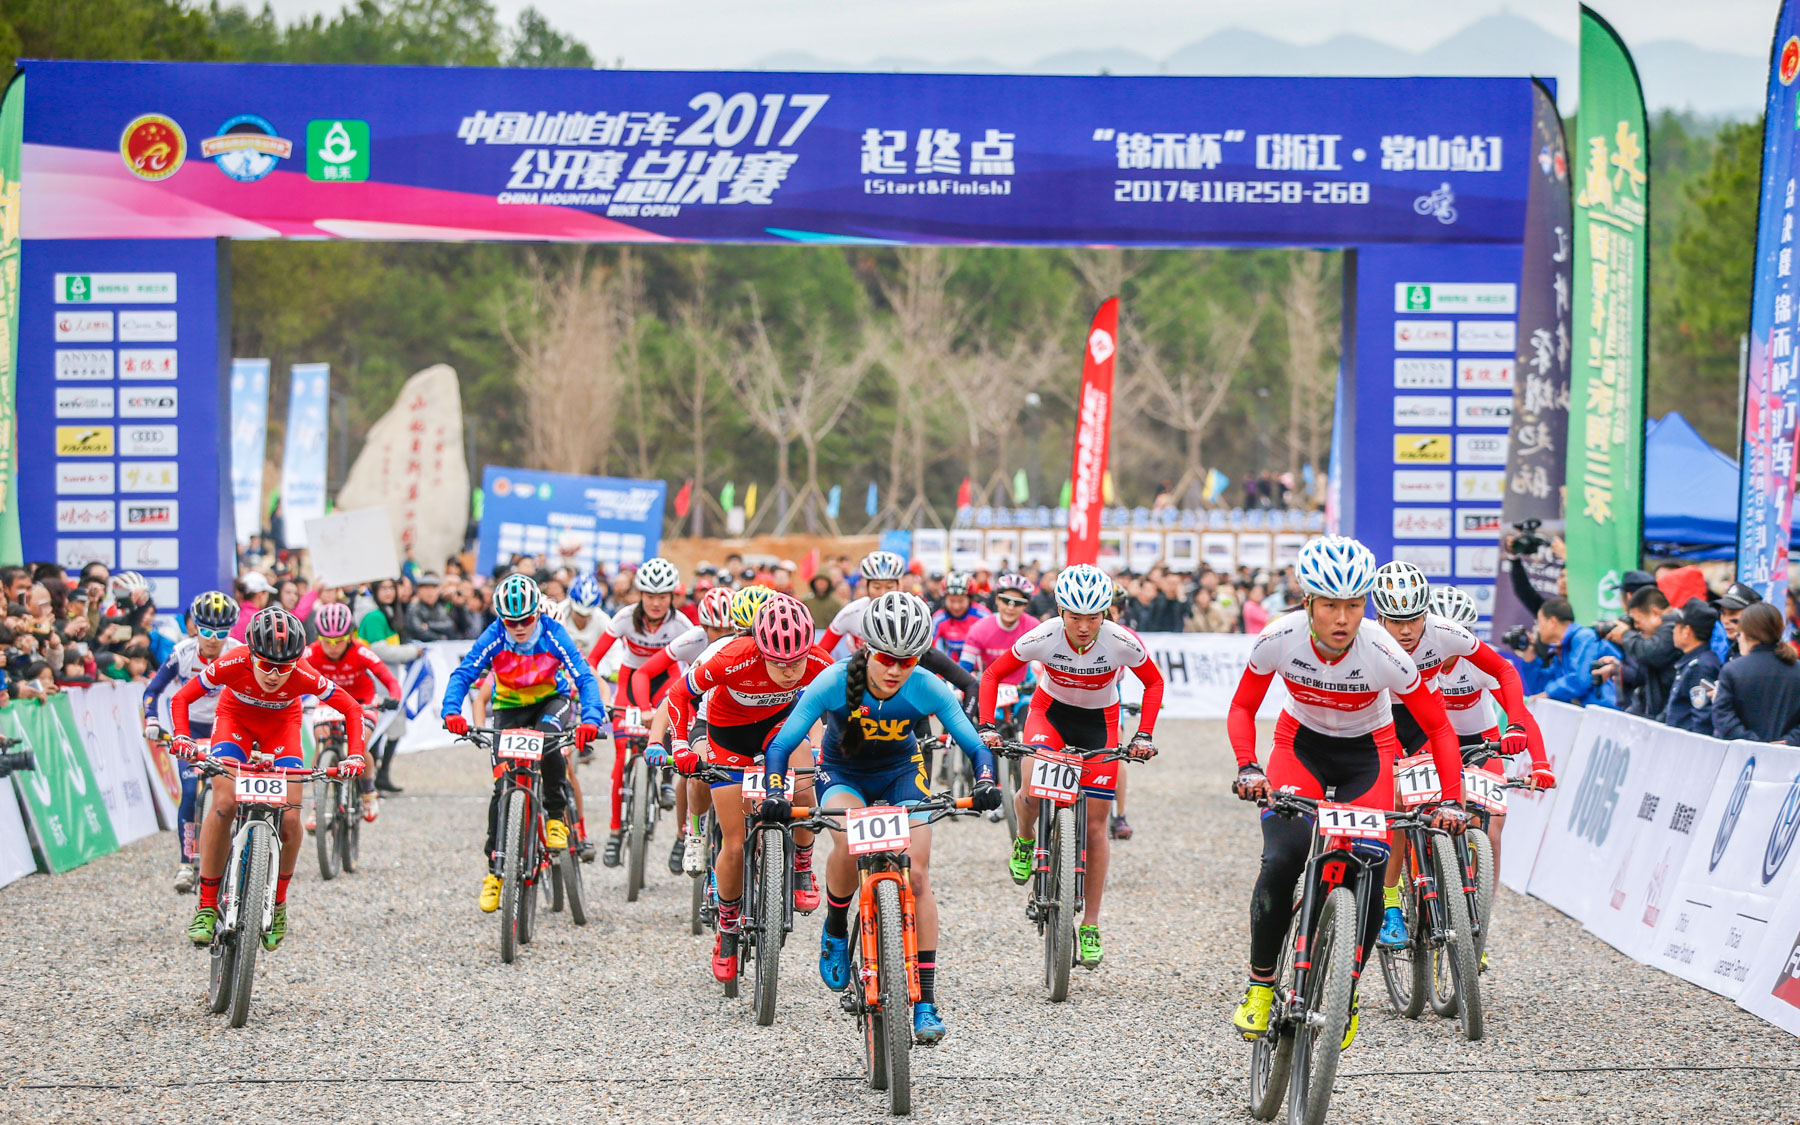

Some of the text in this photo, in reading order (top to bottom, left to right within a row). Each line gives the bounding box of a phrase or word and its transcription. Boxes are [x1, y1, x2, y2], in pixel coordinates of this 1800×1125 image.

[457, 92, 830, 148] 中国山地自行车 2017
[860, 128, 1016, 175] 起终点
[506, 149, 799, 205] 公开赛 总决赛
[497, 190, 612, 207] CHINA MOUNTAIN
[606, 203, 681, 218] BIKE OPEN
[219, 656, 246, 669] Santic
[1284, 671, 1371, 692] IRC轮胎中国车队
[503, 735, 541, 752] 126
[1037, 762, 1075, 790] 110
[240, 778, 284, 795] 108
[852, 814, 903, 841] 101
[1325, 811, 1381, 829] 114
